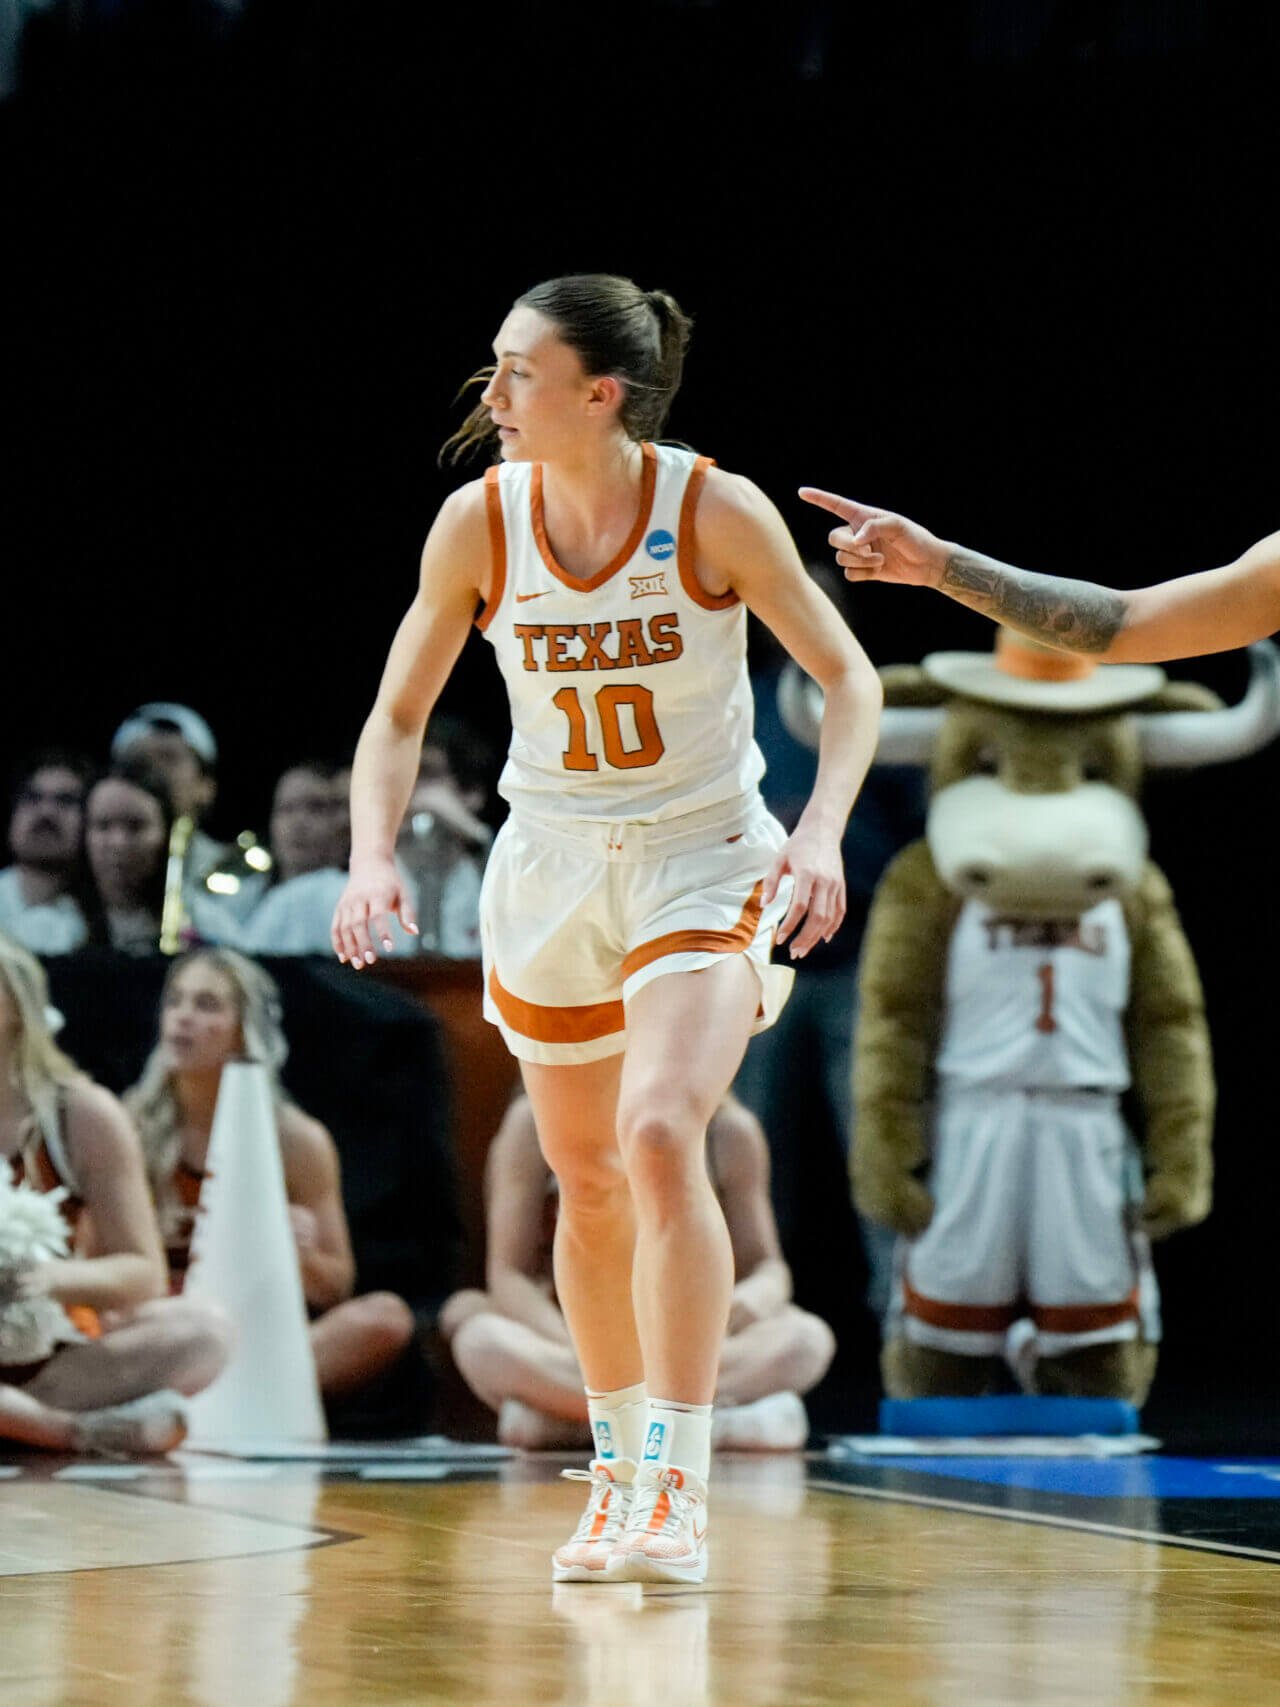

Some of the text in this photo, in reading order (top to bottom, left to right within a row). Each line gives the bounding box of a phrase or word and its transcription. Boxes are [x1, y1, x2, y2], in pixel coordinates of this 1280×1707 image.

[513, 612, 684, 672] TEXAS
[552, 684, 665, 772] 10
[1035, 963, 1057, 1033] 1
